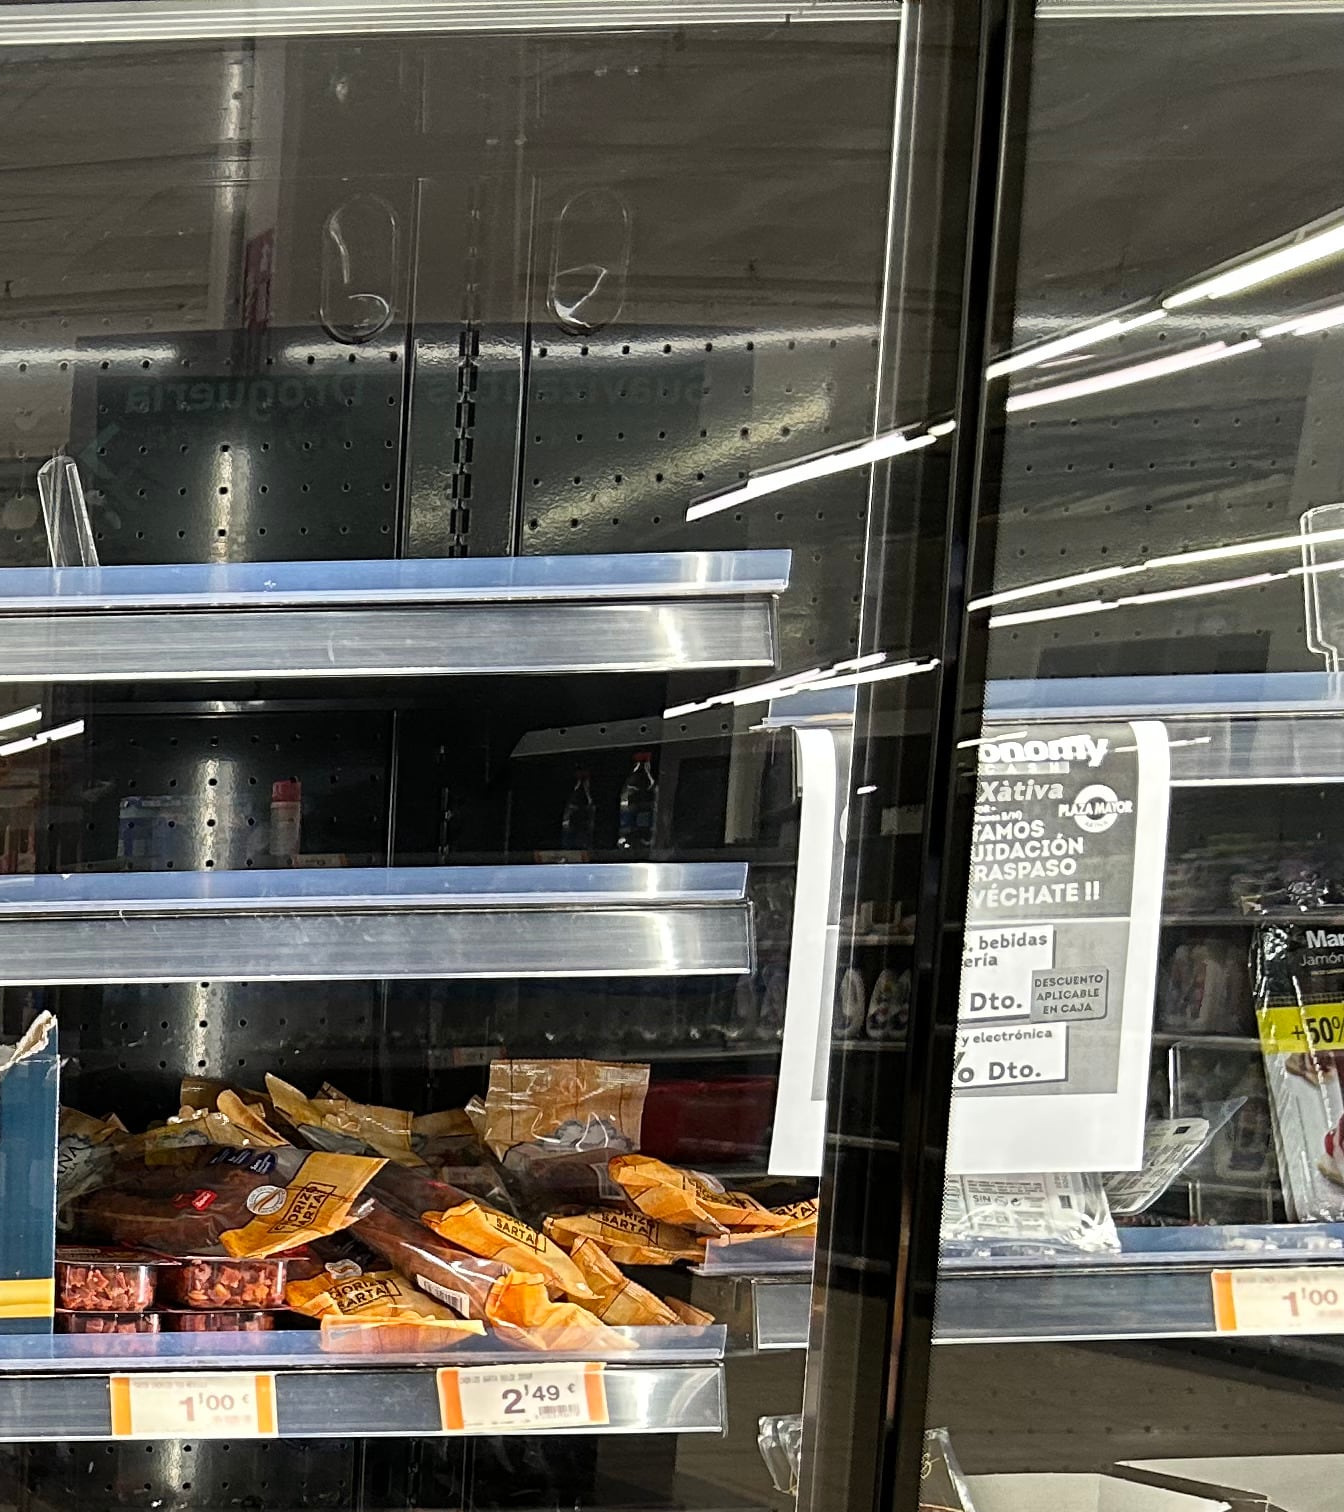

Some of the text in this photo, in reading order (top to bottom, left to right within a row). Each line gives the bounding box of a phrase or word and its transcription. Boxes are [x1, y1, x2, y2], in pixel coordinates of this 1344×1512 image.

[980, 779, 1064, 803] Xàtiva
[1059, 801, 1133, 817] PLAZA MAYOR
[974, 820, 1045, 842] TAMOS
[974, 858, 1077, 882] RASPASO
[973, 882, 1079, 908] VÉCHATE
[979, 933, 1048, 950] bebidas
[1034, 975, 1104, 988] DESCUENTO
[970, 993, 1023, 1012] Dto.
[1036, 988, 1100, 1001] APLICABLE
[1043, 1002, 1093, 1015] EN CAJA
[973, 1029, 1053, 1044] electrónica
[989, 1061, 1042, 1081] Dto.
